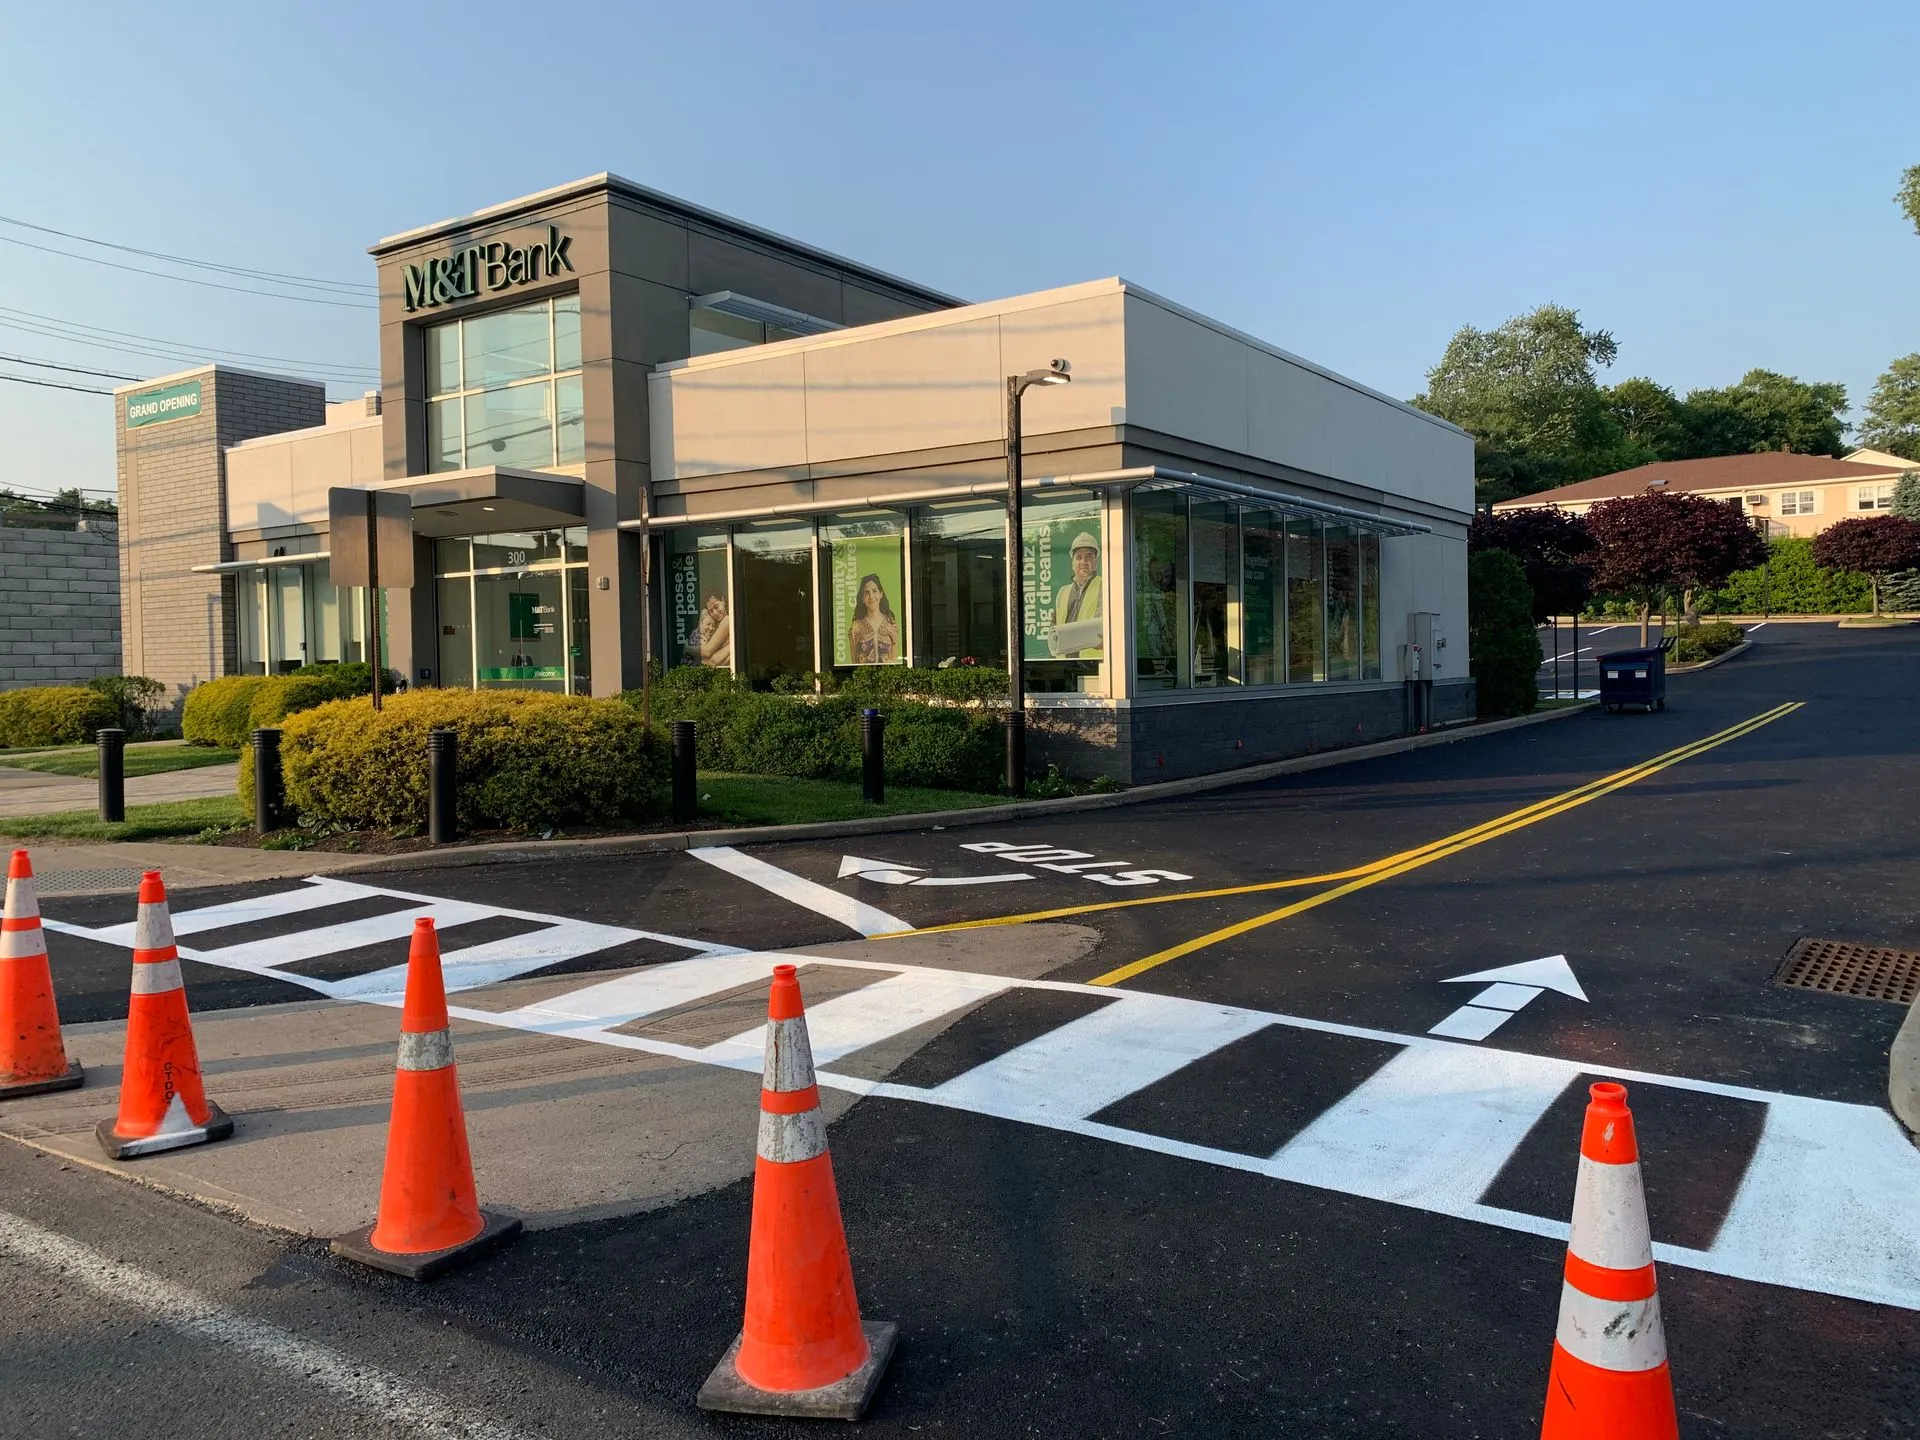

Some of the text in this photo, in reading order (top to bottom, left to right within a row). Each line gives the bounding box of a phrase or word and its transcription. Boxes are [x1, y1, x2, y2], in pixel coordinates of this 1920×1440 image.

[129, 392, 198, 419] GRAND OPENING
[508, 550, 525, 564] 300
[683, 555, 698, 615] people
[846, 543, 858, 608] culture
[1022, 545, 1036, 576] biz
[1036, 525, 1054, 641] big dreams
[671, 556, 688, 645] purpose &
[832, 544, 847, 662] community &
[1022, 580, 1036, 636] small
[959, 842, 1194, 886] STOP
